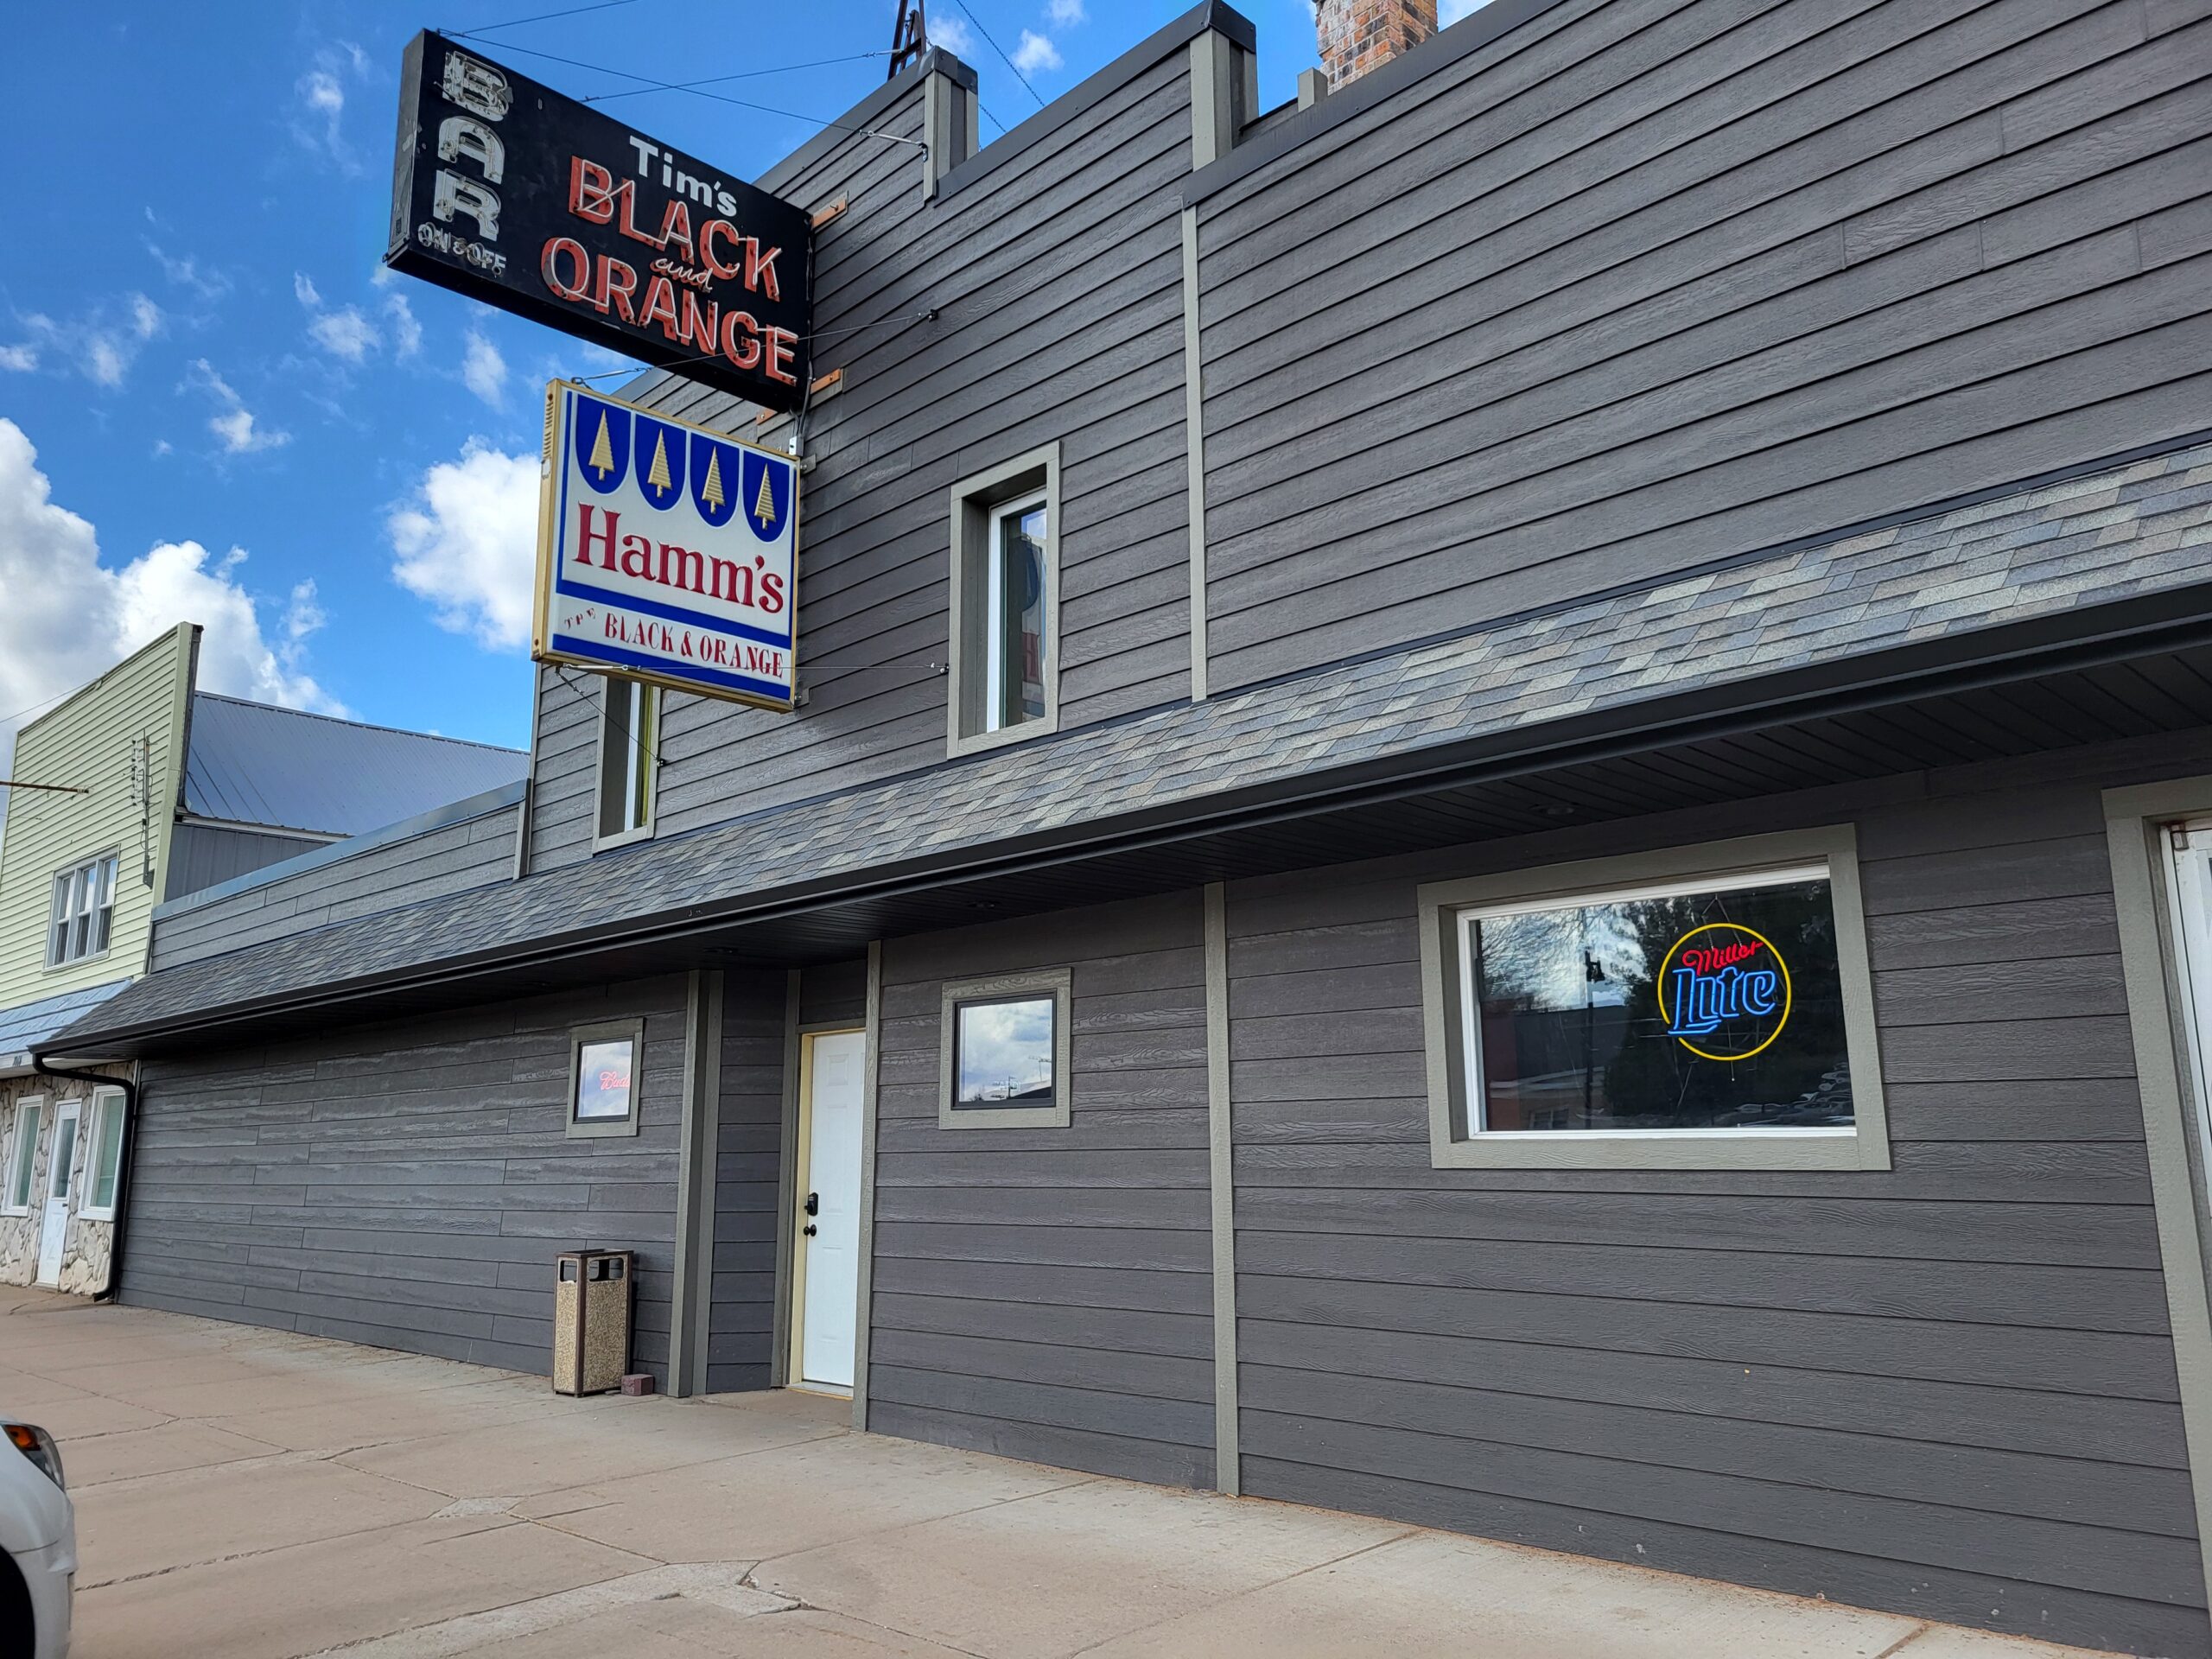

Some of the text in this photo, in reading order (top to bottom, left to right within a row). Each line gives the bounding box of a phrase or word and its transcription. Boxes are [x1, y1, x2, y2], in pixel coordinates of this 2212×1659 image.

[433, 49, 513, 242] BAR
[628, 136, 738, 218] Tim's
[569, 155, 782, 302] BLACK
[541, 237, 798, 387] ORANGE
[650, 257, 714, 293] and
[571, 500, 785, 614] Hamm's
[605, 612, 674, 652] BLACK
[680, 631, 693, 658] &
[699, 635, 784, 679] ORANGE
[1682, 940, 1764, 976] Miller
[1668, 966, 1777, 1035] Lite
